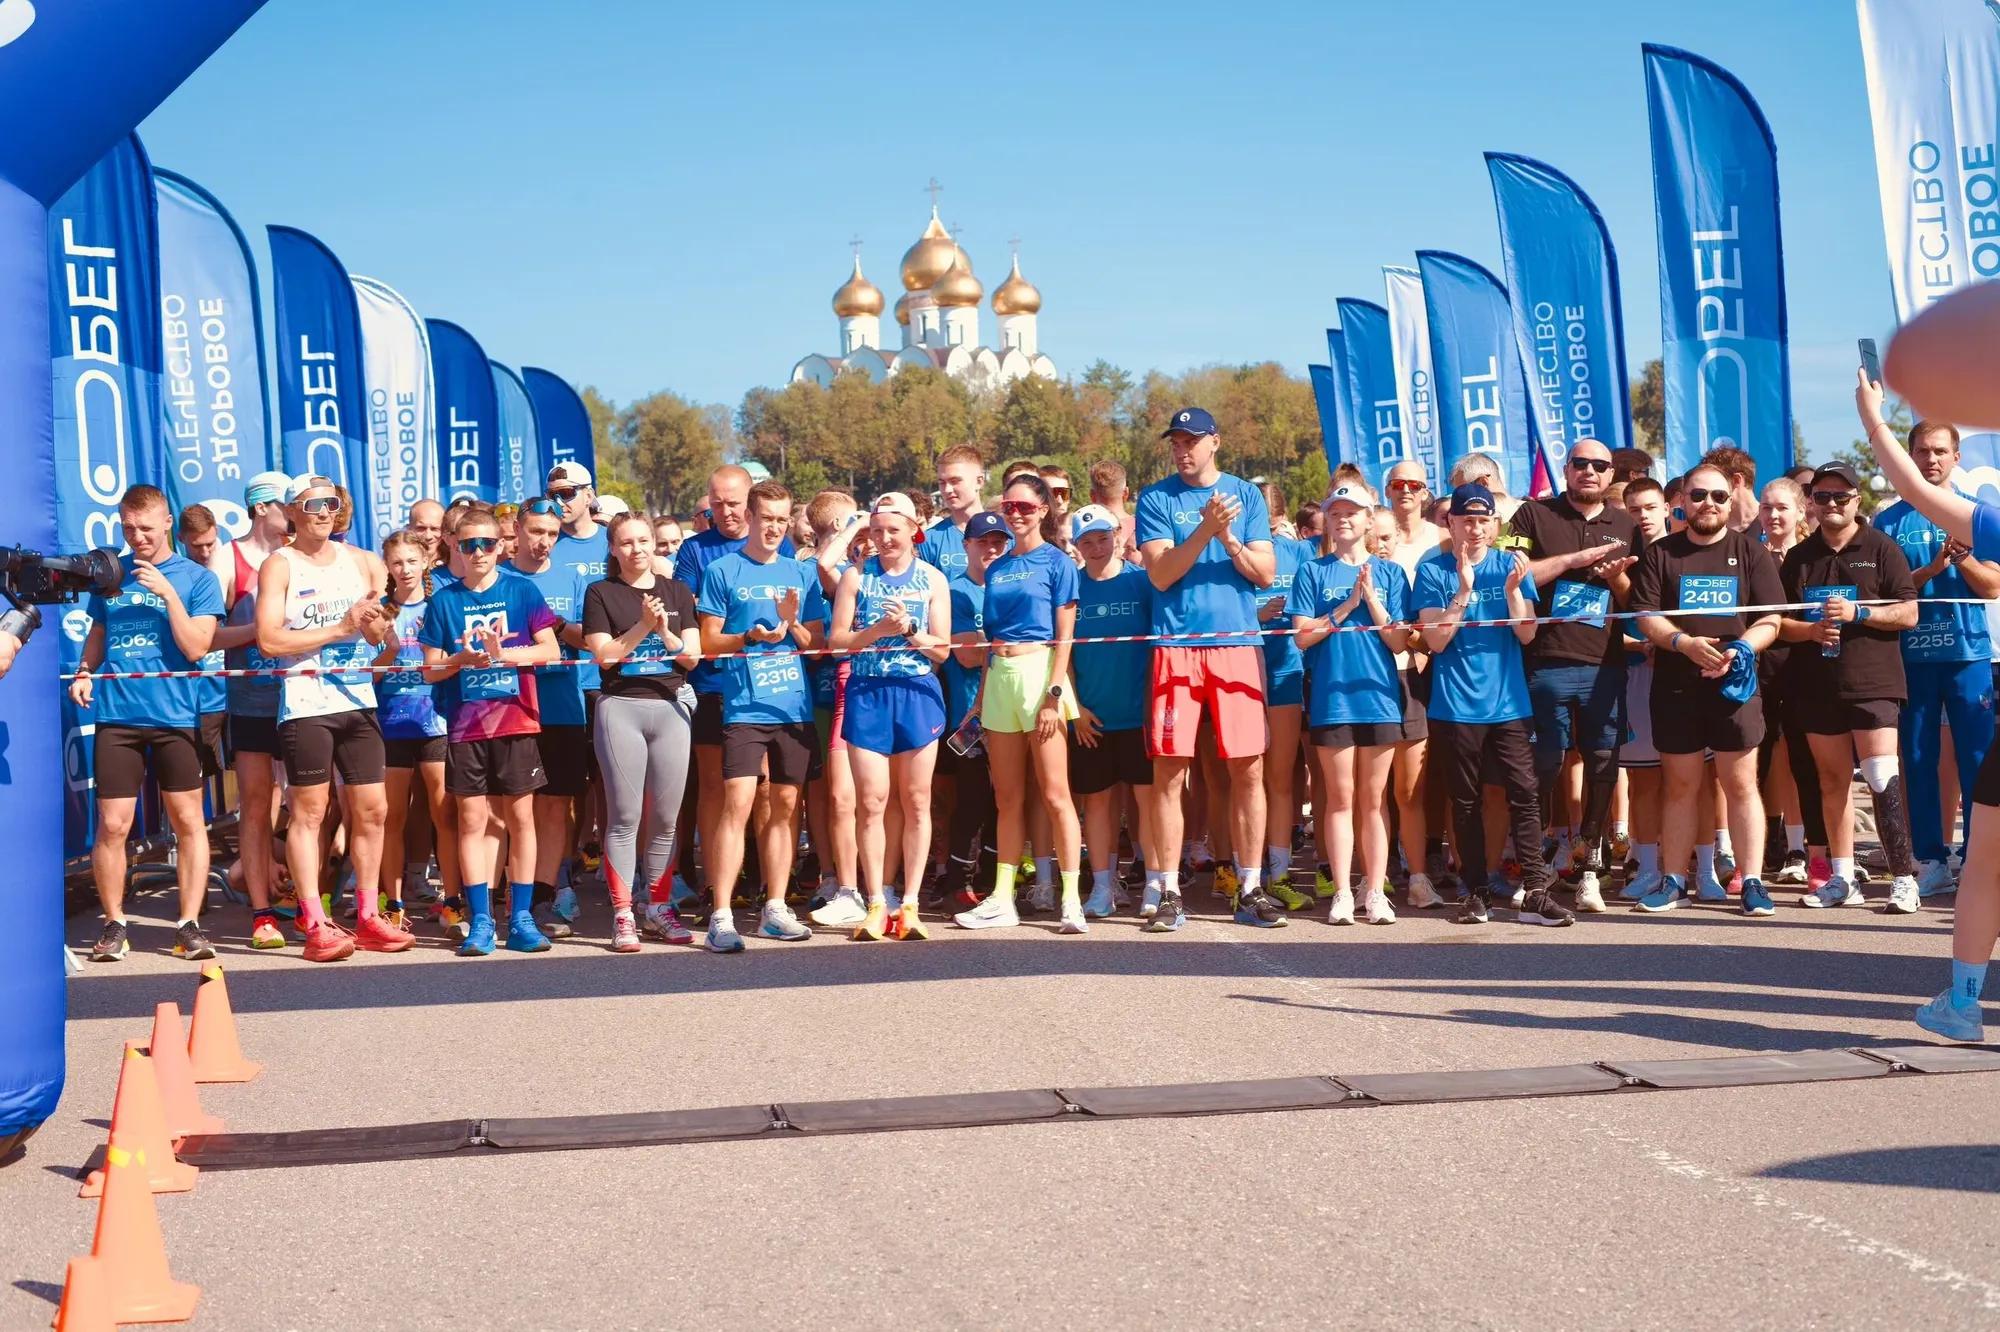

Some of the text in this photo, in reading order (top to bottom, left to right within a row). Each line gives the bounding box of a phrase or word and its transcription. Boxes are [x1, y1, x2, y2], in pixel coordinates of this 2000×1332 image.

[301, 334, 346, 487] БЕГ
[450, 406, 479, 500] БЕГ
[1896, 529, 1947, 547] ЗОБ
[566, 562, 608, 576] ОБЕ
[991, 571, 1036, 585] ЗОБЕГ
[1684, 578, 1733, 588] ЗОБЕГ
[737, 585, 804, 601] ЗОБГ
[1322, 586, 1388, 602] ЗОЕГ
[1559, 583, 1606, 599] ЗОБЕГ
[1684, 590, 1733, 604] 2410
[106, 591, 167, 608] ОБЕ
[463, 601, 506, 612] МАРАФОН
[546, 597, 573, 610] БЕГ
[871, 601, 919, 612] ЗЕГ
[1557, 595, 1602, 616] 2414
[1075, 601, 1140, 621] ЗОБЕГ
[110, 620, 155, 633] ЗОБЕГ
[109, 633, 159, 649] 2062
[1907, 633, 1956, 649] 2255
[206, 651, 225, 665] 23
[326, 645, 367, 655] ЗОБЕГ
[752, 655, 795, 671] ЗОБЕГ
[466, 671, 513, 689] 2215
[756, 667, 800, 687] 2316
